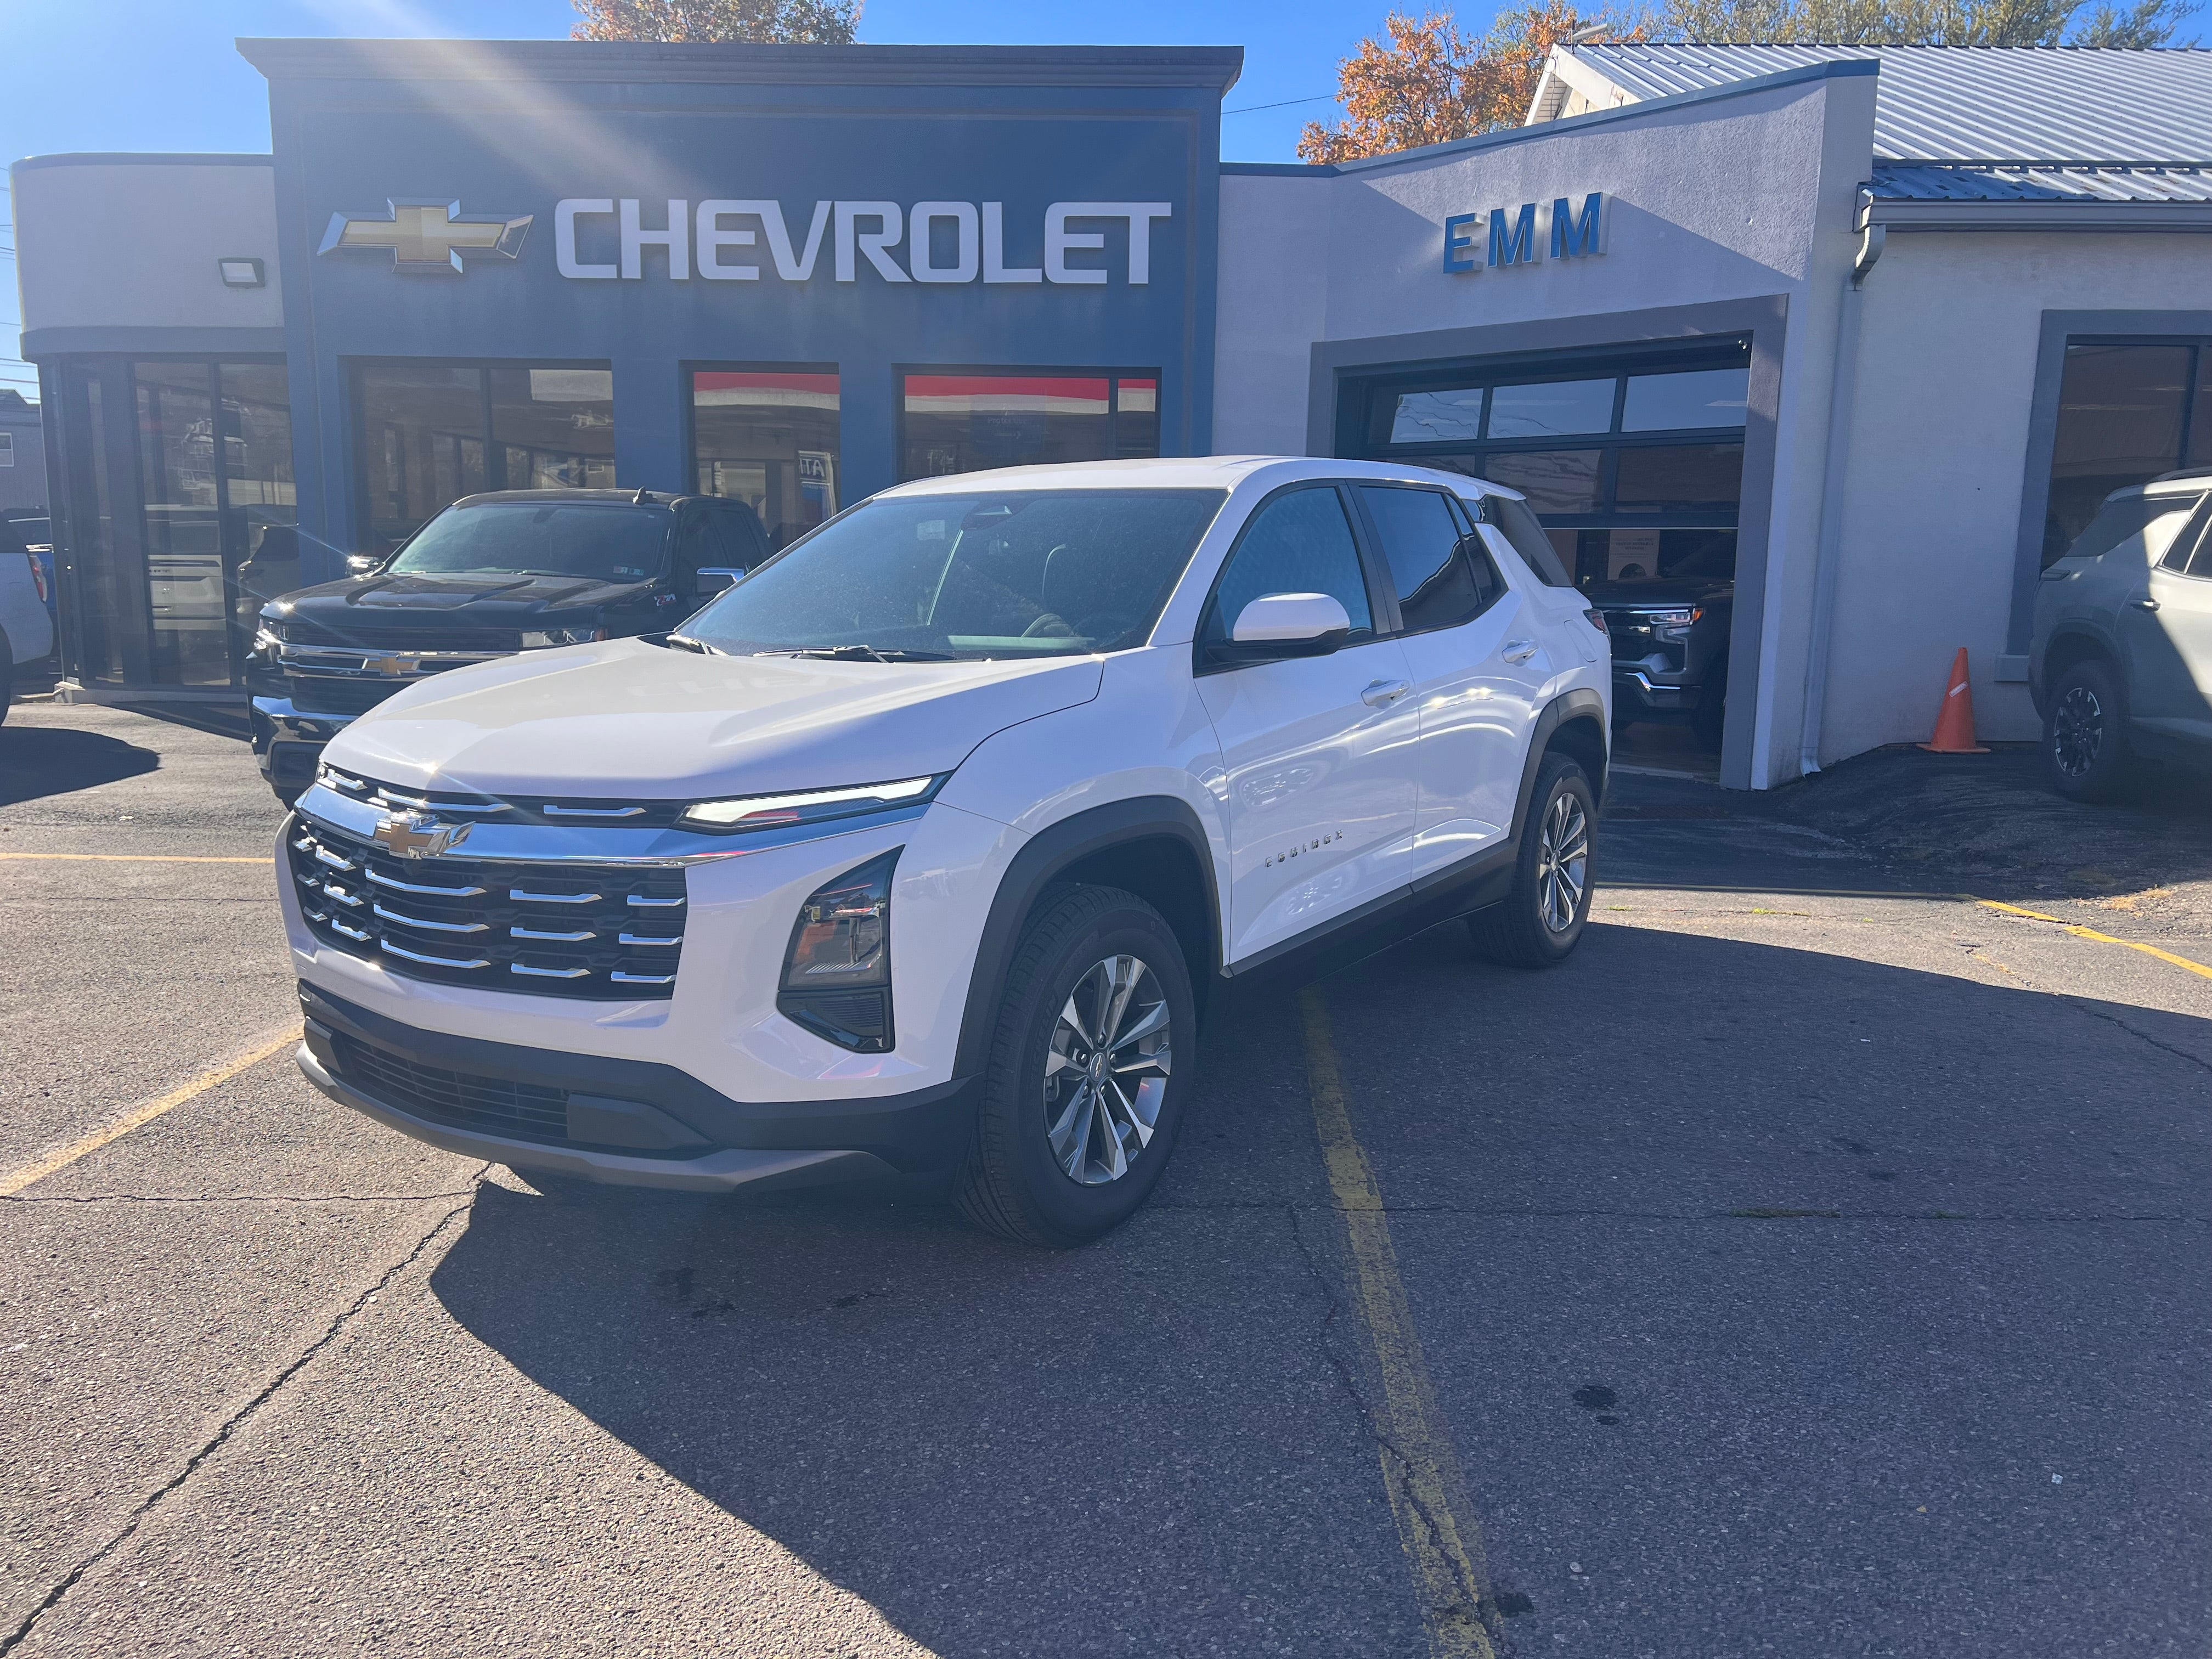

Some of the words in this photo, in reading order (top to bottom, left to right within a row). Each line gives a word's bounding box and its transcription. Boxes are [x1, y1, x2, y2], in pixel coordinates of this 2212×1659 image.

[554, 199, 1172, 284] CHEVROLET
[1443, 192, 1607, 274] EMM
[1265, 829, 1343, 867] EQUINOX
